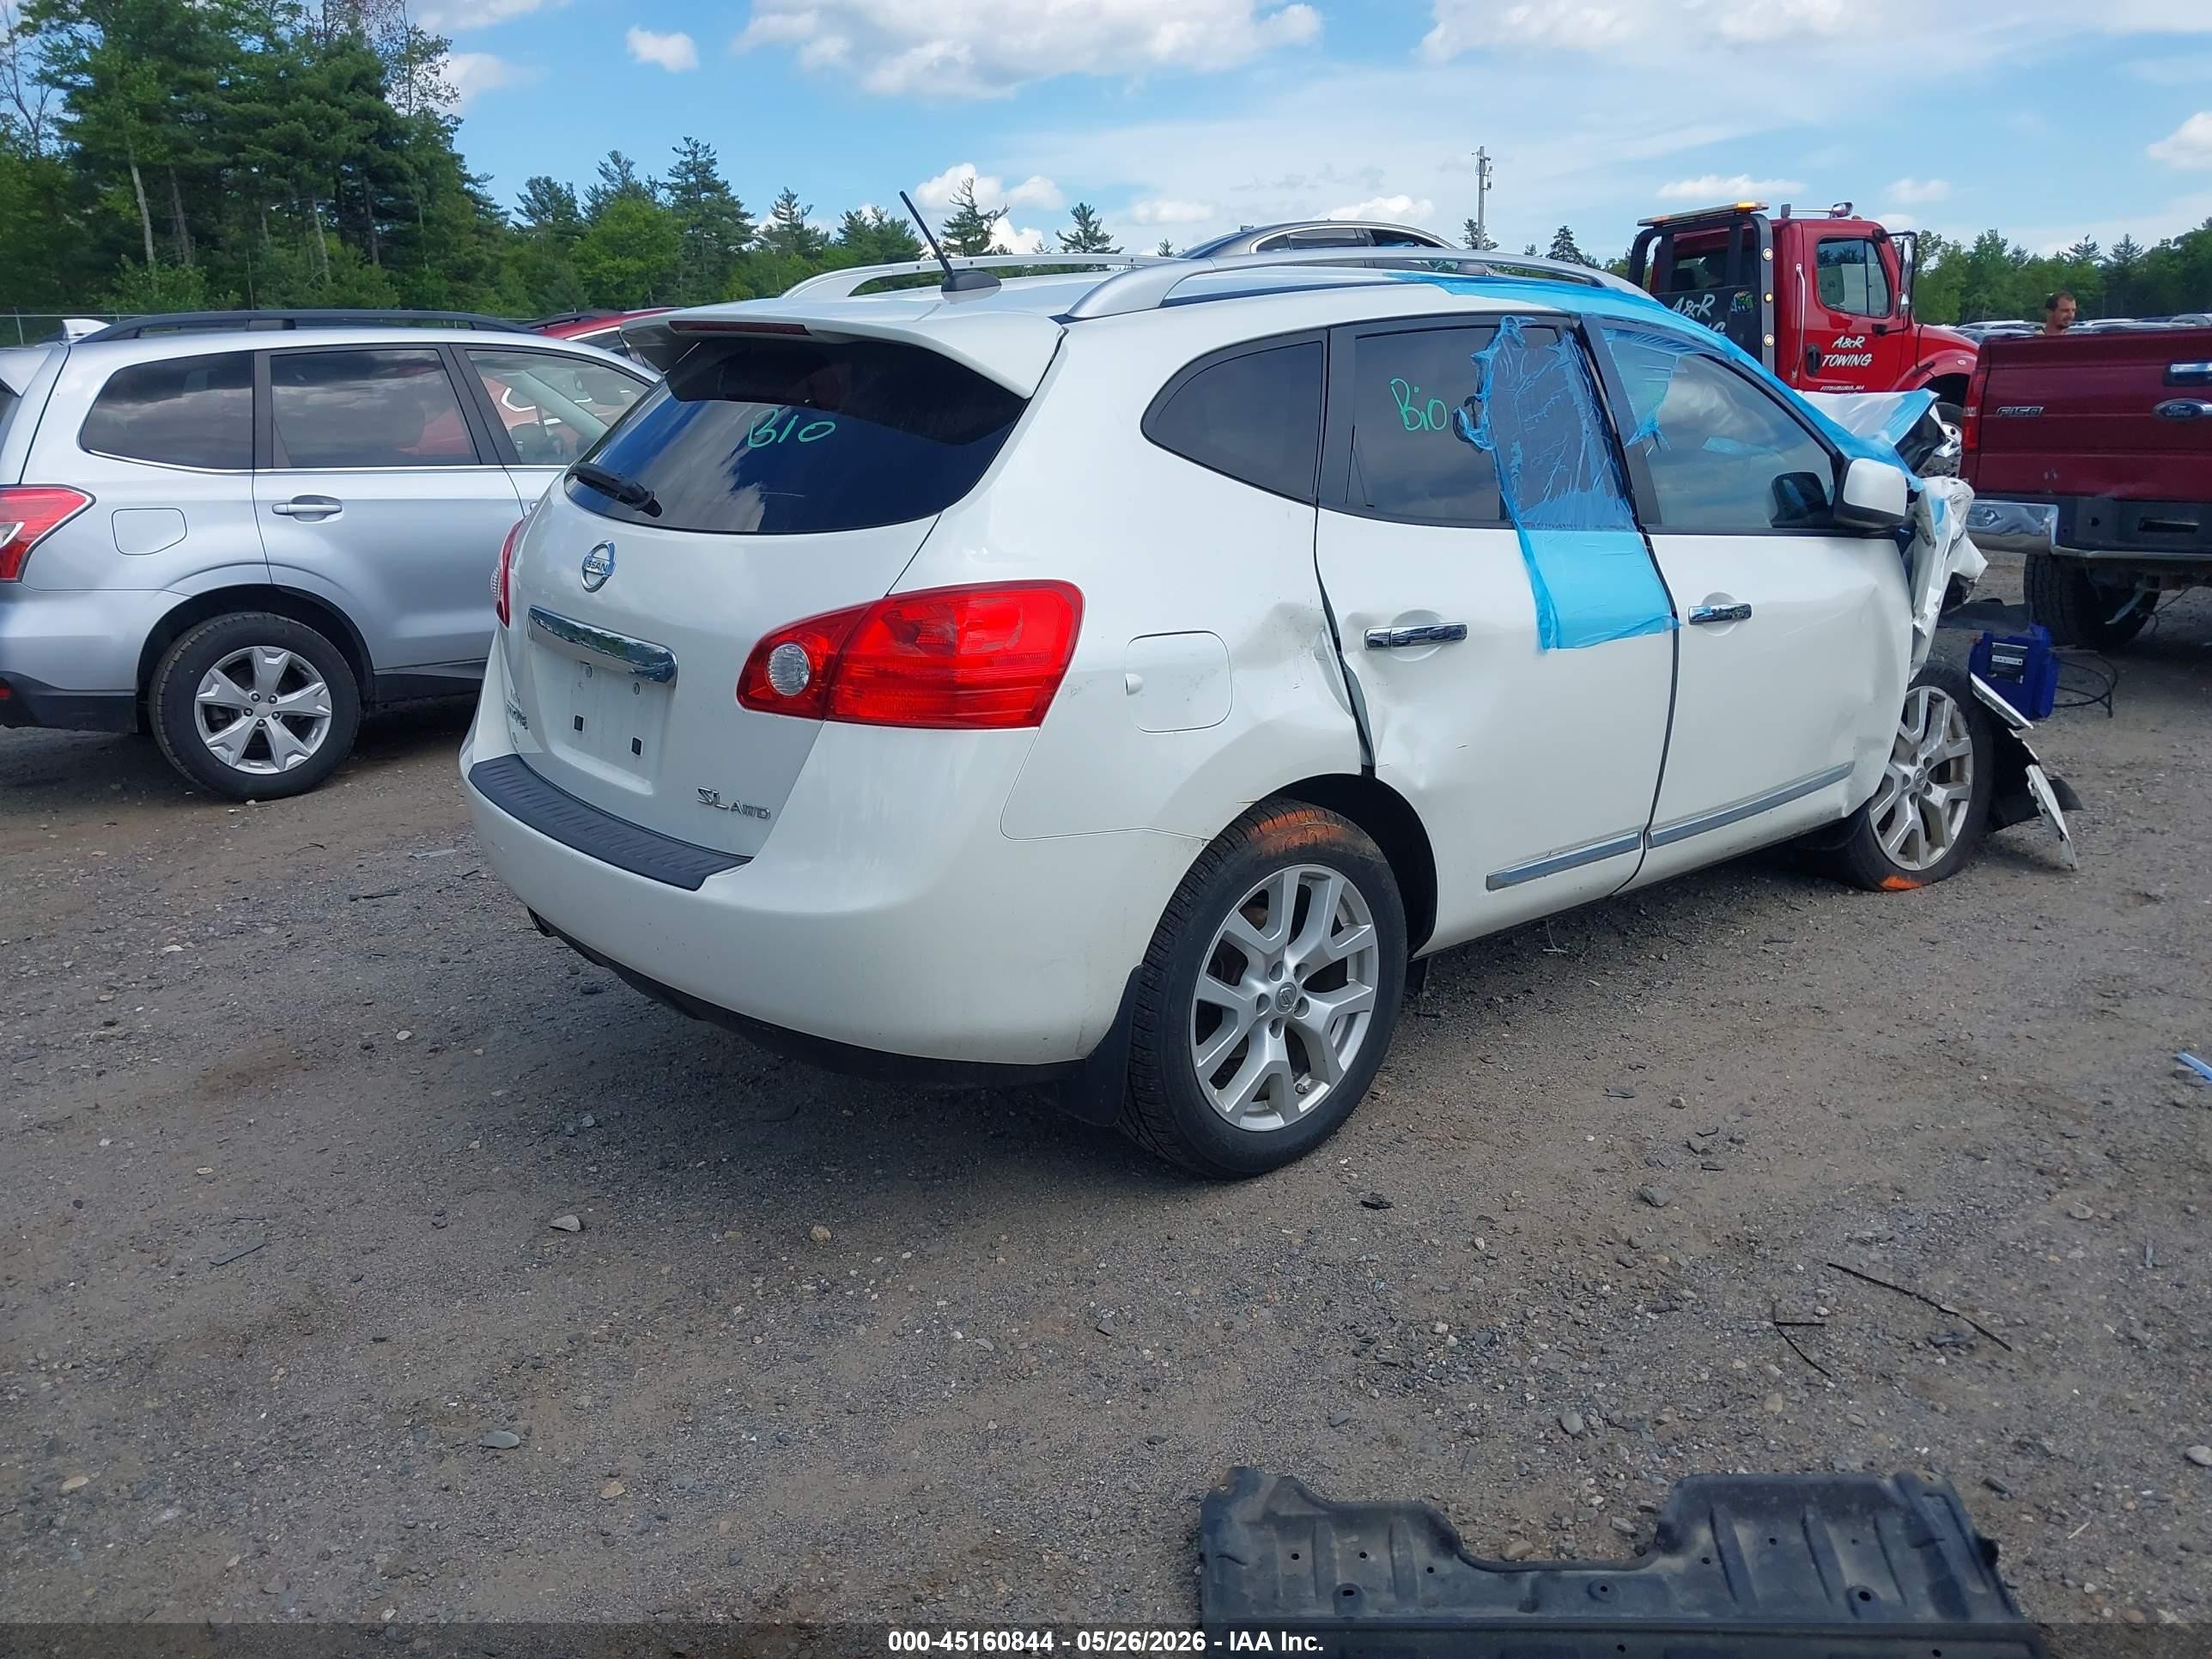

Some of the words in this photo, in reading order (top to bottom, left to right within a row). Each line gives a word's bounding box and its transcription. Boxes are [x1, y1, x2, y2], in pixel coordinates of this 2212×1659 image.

[1672, 294, 1716, 318] A&R
[1832, 335, 1865, 349] A&R
[1821, 353, 1872, 367] TOWING
[696, 787, 728, 810] SL
